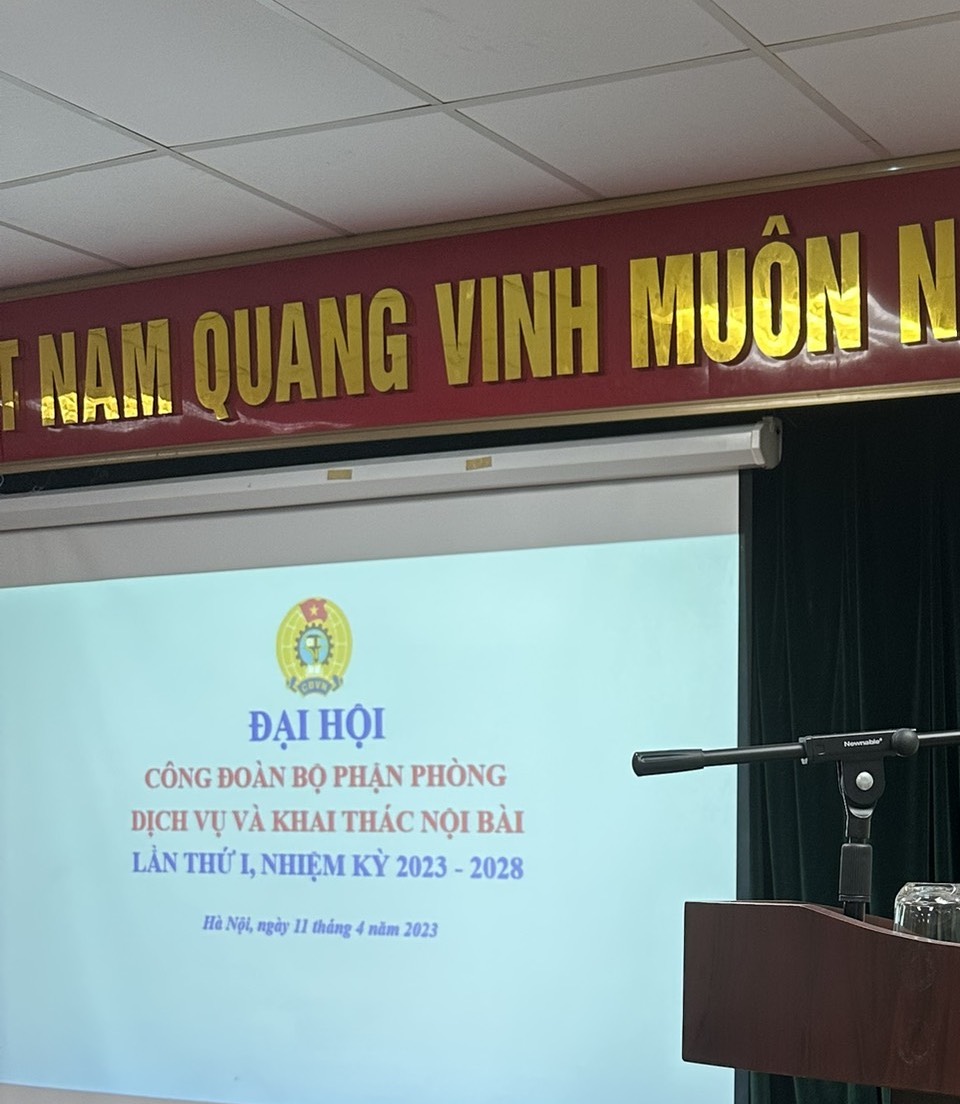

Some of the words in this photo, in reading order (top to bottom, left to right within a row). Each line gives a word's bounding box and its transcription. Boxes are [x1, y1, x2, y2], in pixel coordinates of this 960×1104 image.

[38, 318, 173, 428] NAM
[193, 287, 409, 422] QUANG
[434, 263, 599, 386] VINH
[629, 214, 862, 370] MUÔN
[249, 709, 310, 750] ĐẠI
[318, 703, 386, 749] HỘI
[145, 761, 212, 789] CÔNG
[218, 760, 286, 788] ĐOÀN
[292, 763, 327, 794] BỘ
[333, 762, 404, 794] PHẬN
[411, 757, 507, 787] PHÒNG
[131, 809, 188, 838] DỊCH
[194, 809, 227, 838] VỤ
[232, 804, 265, 832] VÀ
[272, 810, 336, 832] KHAI
[341, 804, 414, 833] THÁC
[421, 808, 470, 840] NỘI
[477, 804, 524, 834] BÀI
[132, 845, 178, 873] LẦN
[183, 846, 236, 874] THỨ
[240, 852, 256, 879] I,
[261, 851, 346, 882] NHIỆM
[352, 848, 390, 877] KỲ
[396, 855, 447, 878] 2023
[470, 856, 524, 880] 2028
[203, 915, 222, 931] Hà
[225, 915, 253, 935] Nội,
[257, 917, 290, 936] ngày
[294, 918, 308, 934] 11
[312, 918, 352, 938] tháng
[356, 920, 365, 936] 4
[368, 921, 400, 937] năm
[404, 922, 439, 938] 2023
